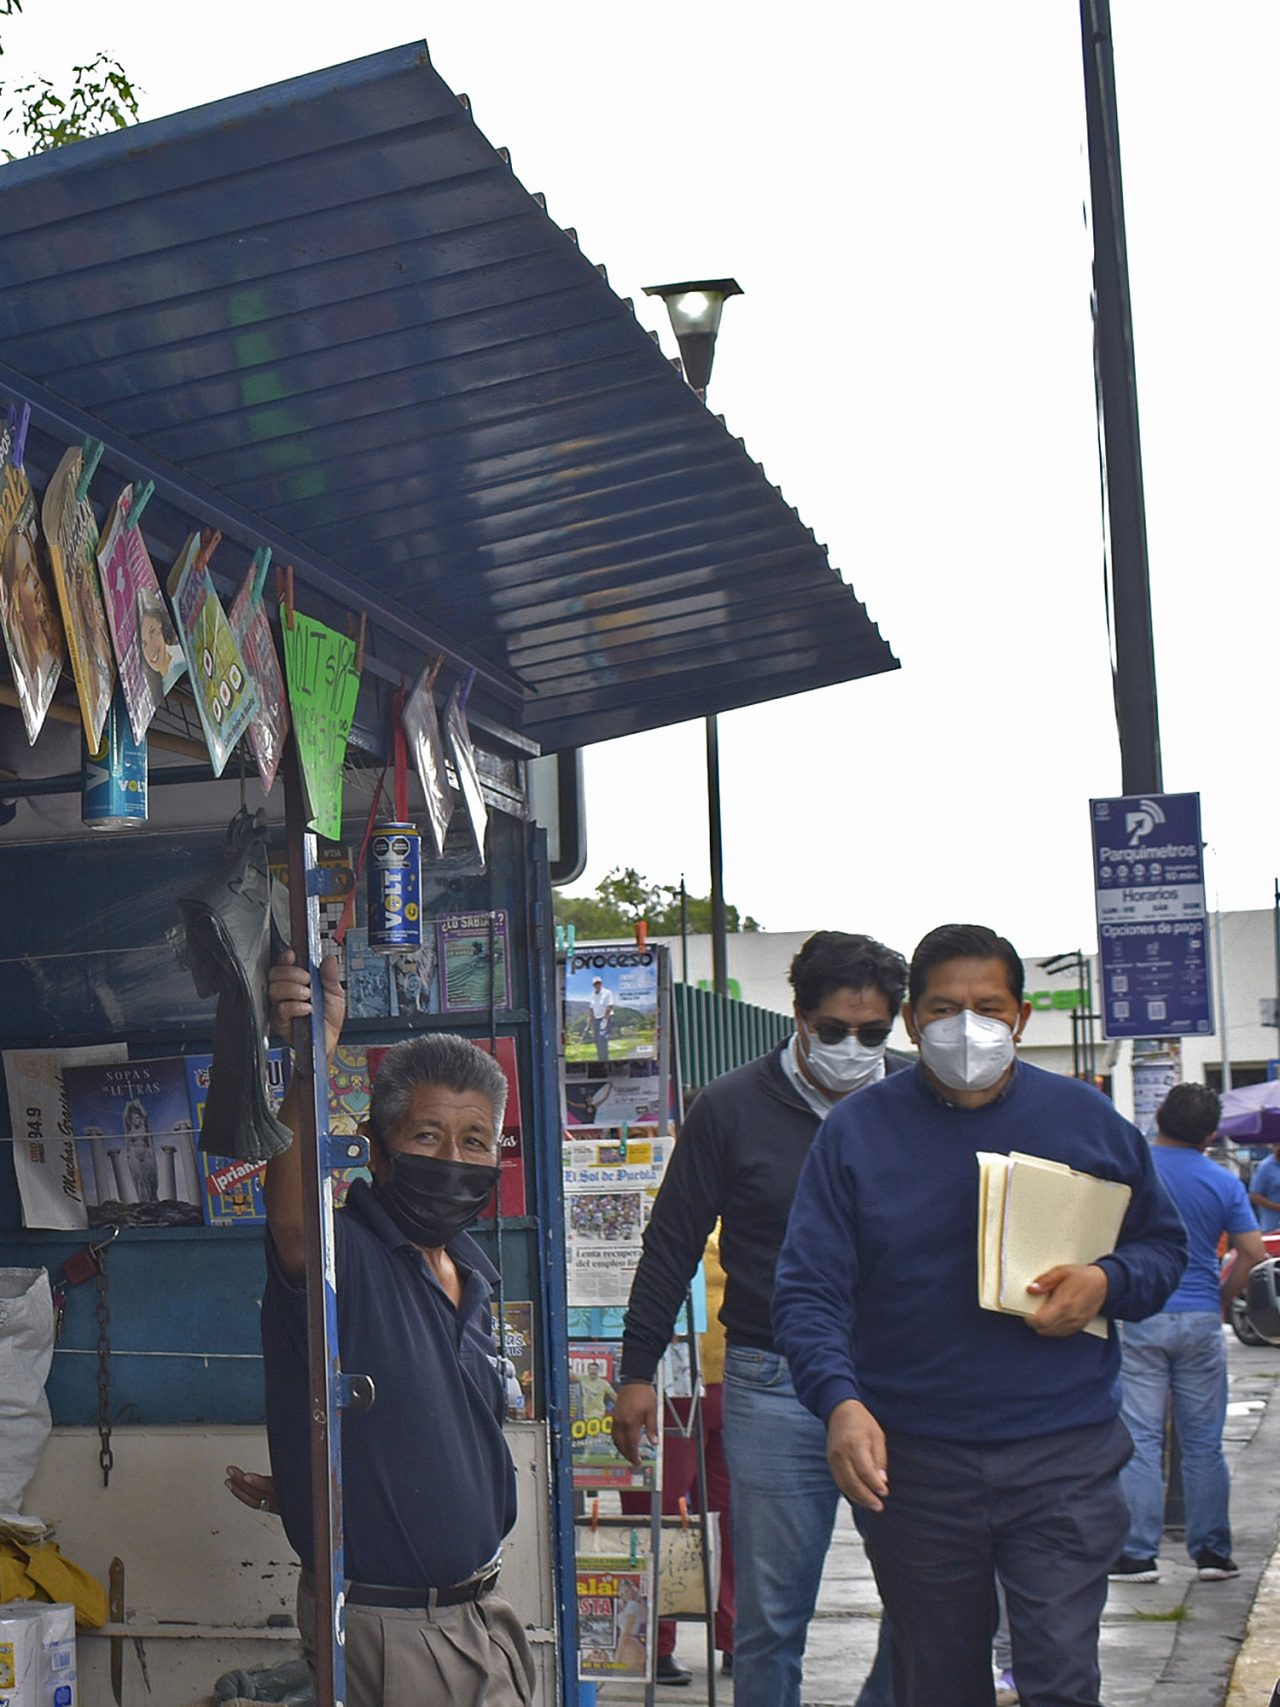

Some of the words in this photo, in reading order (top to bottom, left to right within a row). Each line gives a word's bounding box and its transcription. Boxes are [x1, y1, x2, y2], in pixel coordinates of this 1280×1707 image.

[1100, 845, 1197, 863] Parquímetros
[384, 870, 403, 928] VOLT
[1123, 888, 1178, 902] Horarios
[1101, 923, 1155, 938] Opciones
[1157, 922, 1172, 933] de
[1174, 922, 1202, 935] pago
[570, 953, 652, 974] proceso
[106, 1069, 150, 1080] SOPAS
[580, 1170, 599, 1182] Sol
